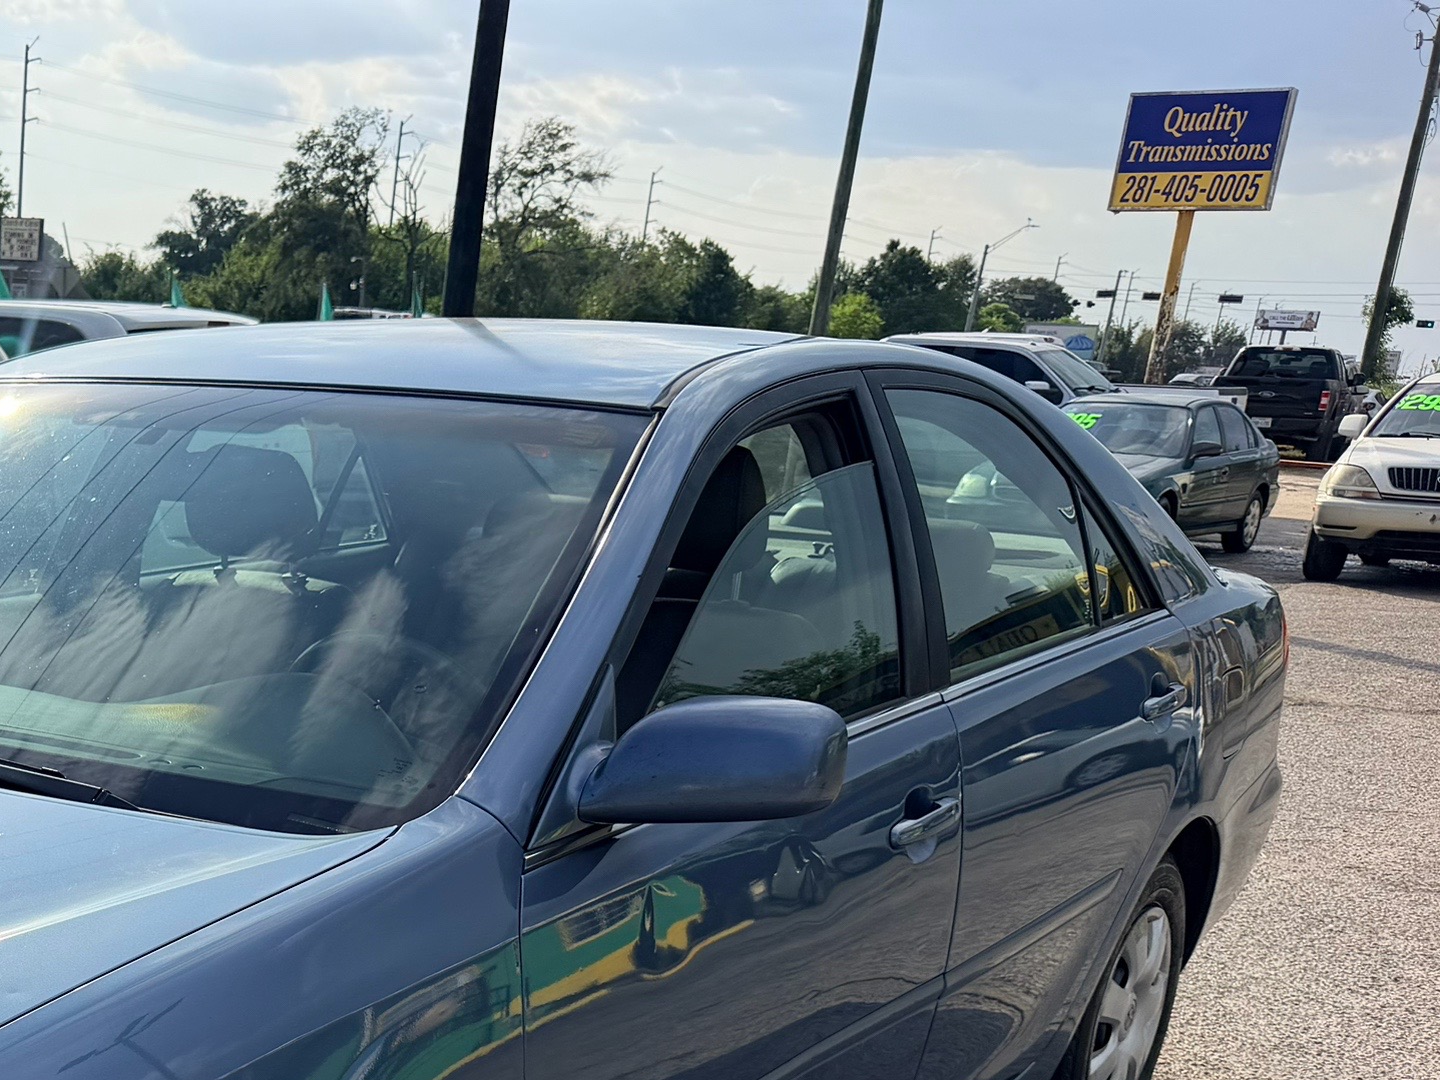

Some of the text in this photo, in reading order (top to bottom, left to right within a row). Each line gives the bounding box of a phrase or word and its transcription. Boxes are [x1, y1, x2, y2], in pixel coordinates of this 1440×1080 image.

[1164, 103, 1248, 137] Quality
[1126, 137, 1272, 163] Transmissions
[1119, 173, 1264, 203] 281-405-0005
